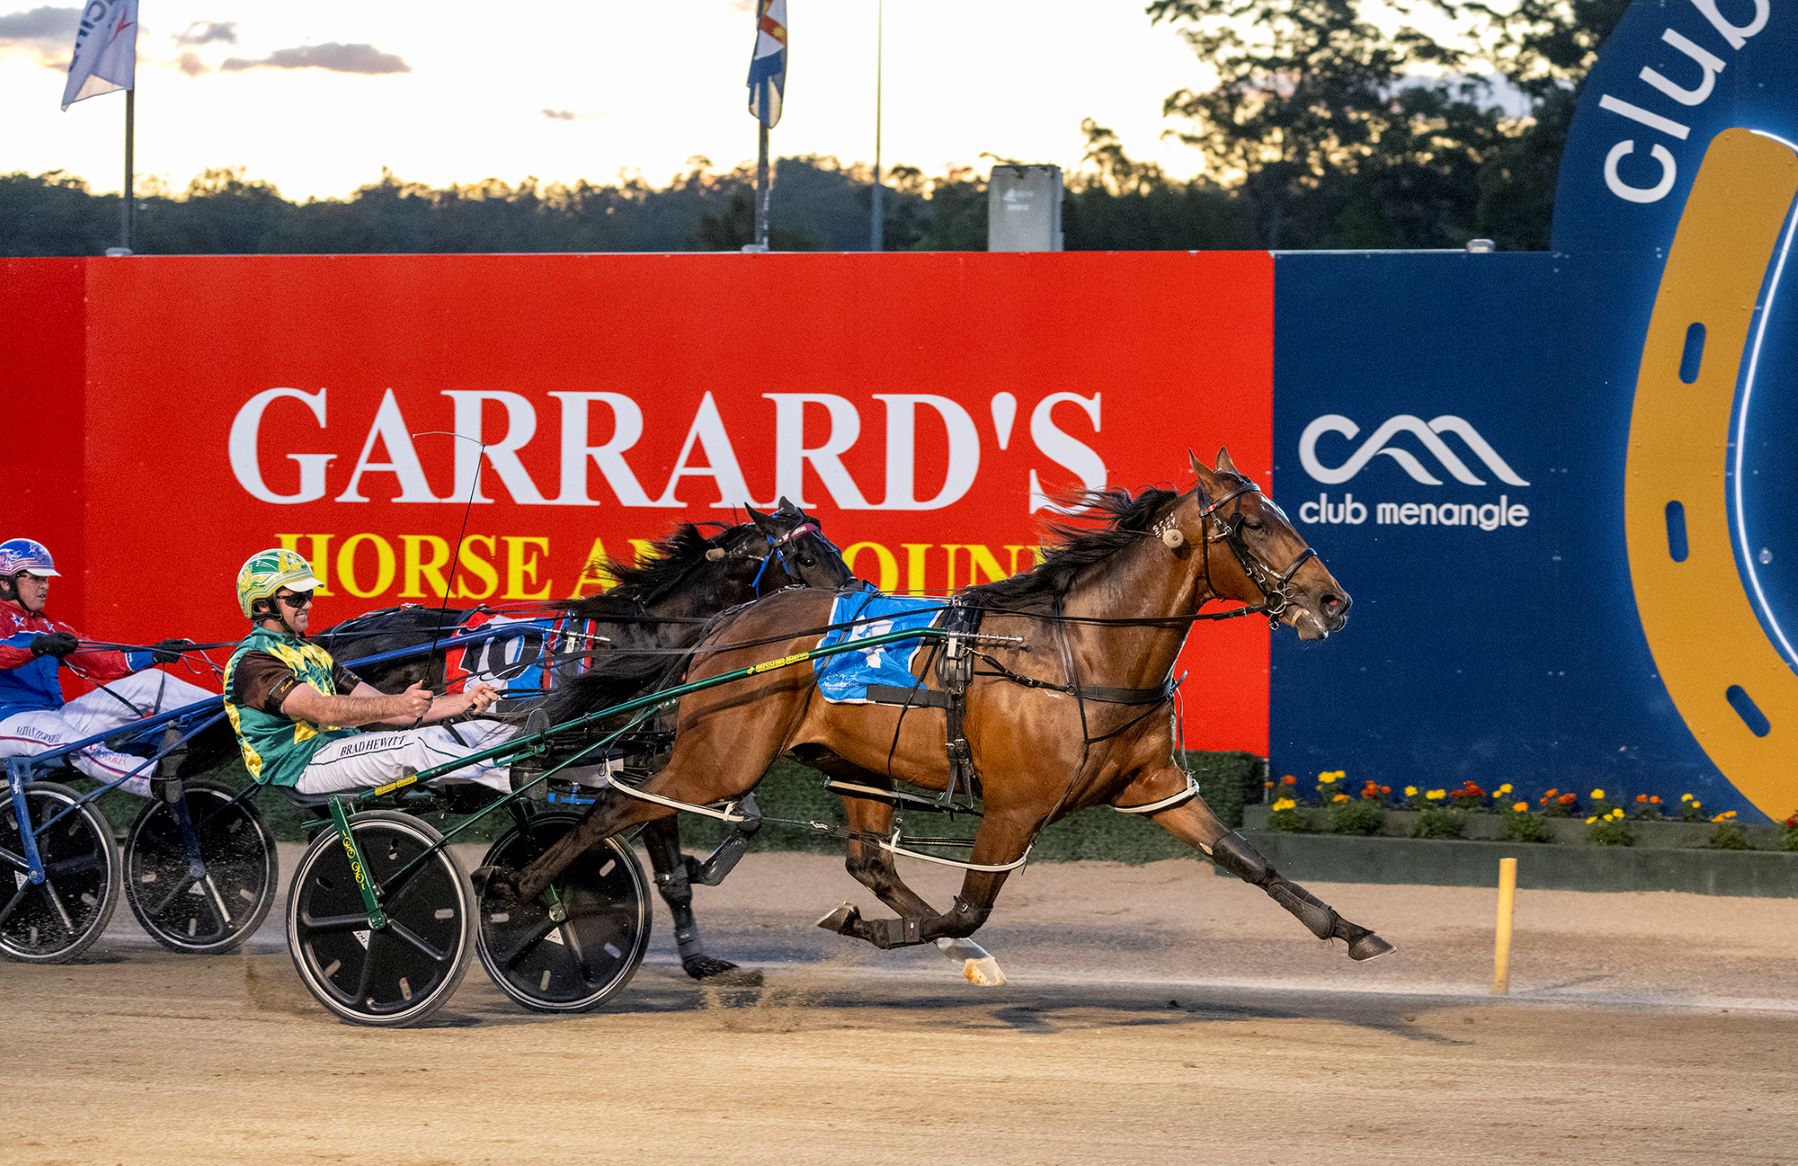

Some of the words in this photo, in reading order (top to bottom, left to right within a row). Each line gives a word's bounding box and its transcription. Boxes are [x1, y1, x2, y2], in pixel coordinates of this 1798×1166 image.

[1599, 0, 1771, 204] club
[229, 387, 1108, 515] GARRARD'S
[1299, 492, 1368, 525] club
[1376, 494, 1530, 532] menangle
[275, 532, 552, 600] HORSE
